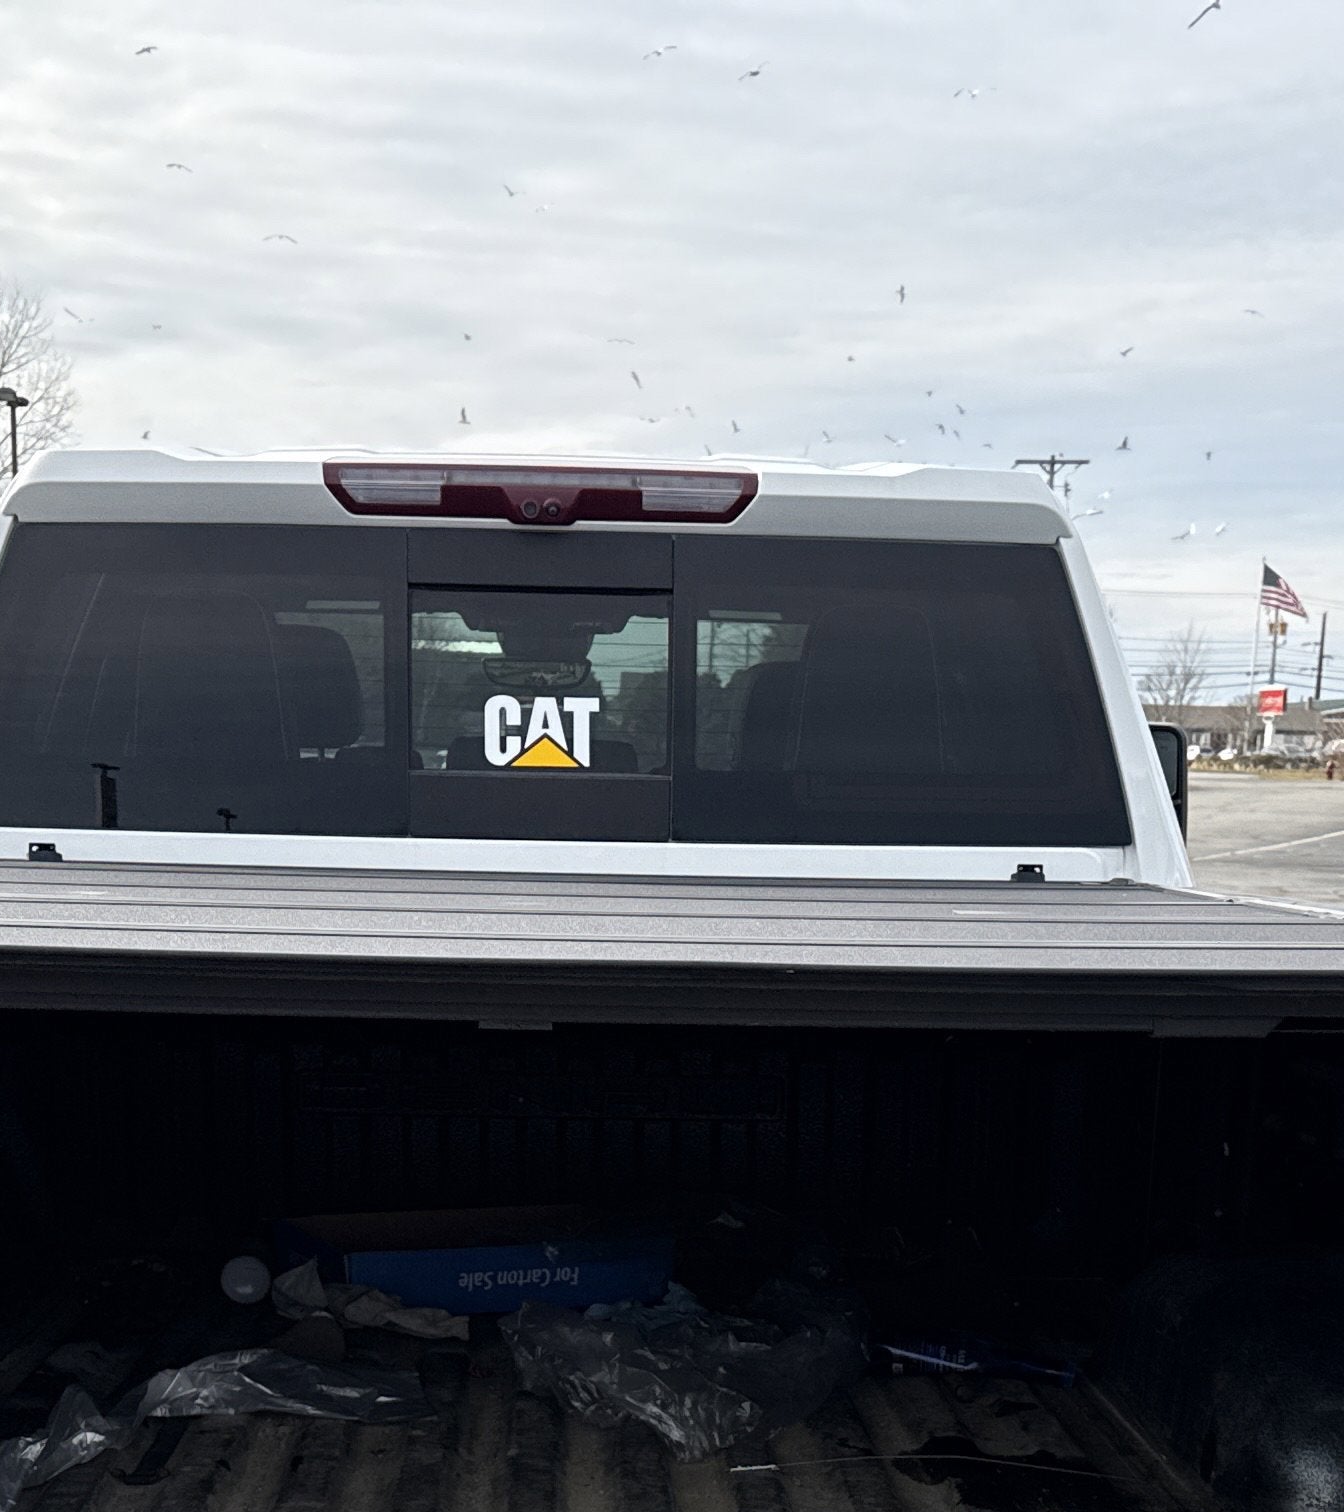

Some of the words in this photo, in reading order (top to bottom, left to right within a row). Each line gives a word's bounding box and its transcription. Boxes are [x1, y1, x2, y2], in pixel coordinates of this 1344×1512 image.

[484, 694, 600, 768] CAT
[458, 1271, 494, 1292] Sale
[496, 1267, 551, 1288] Carton
[553, 1266, 580, 1286] For
